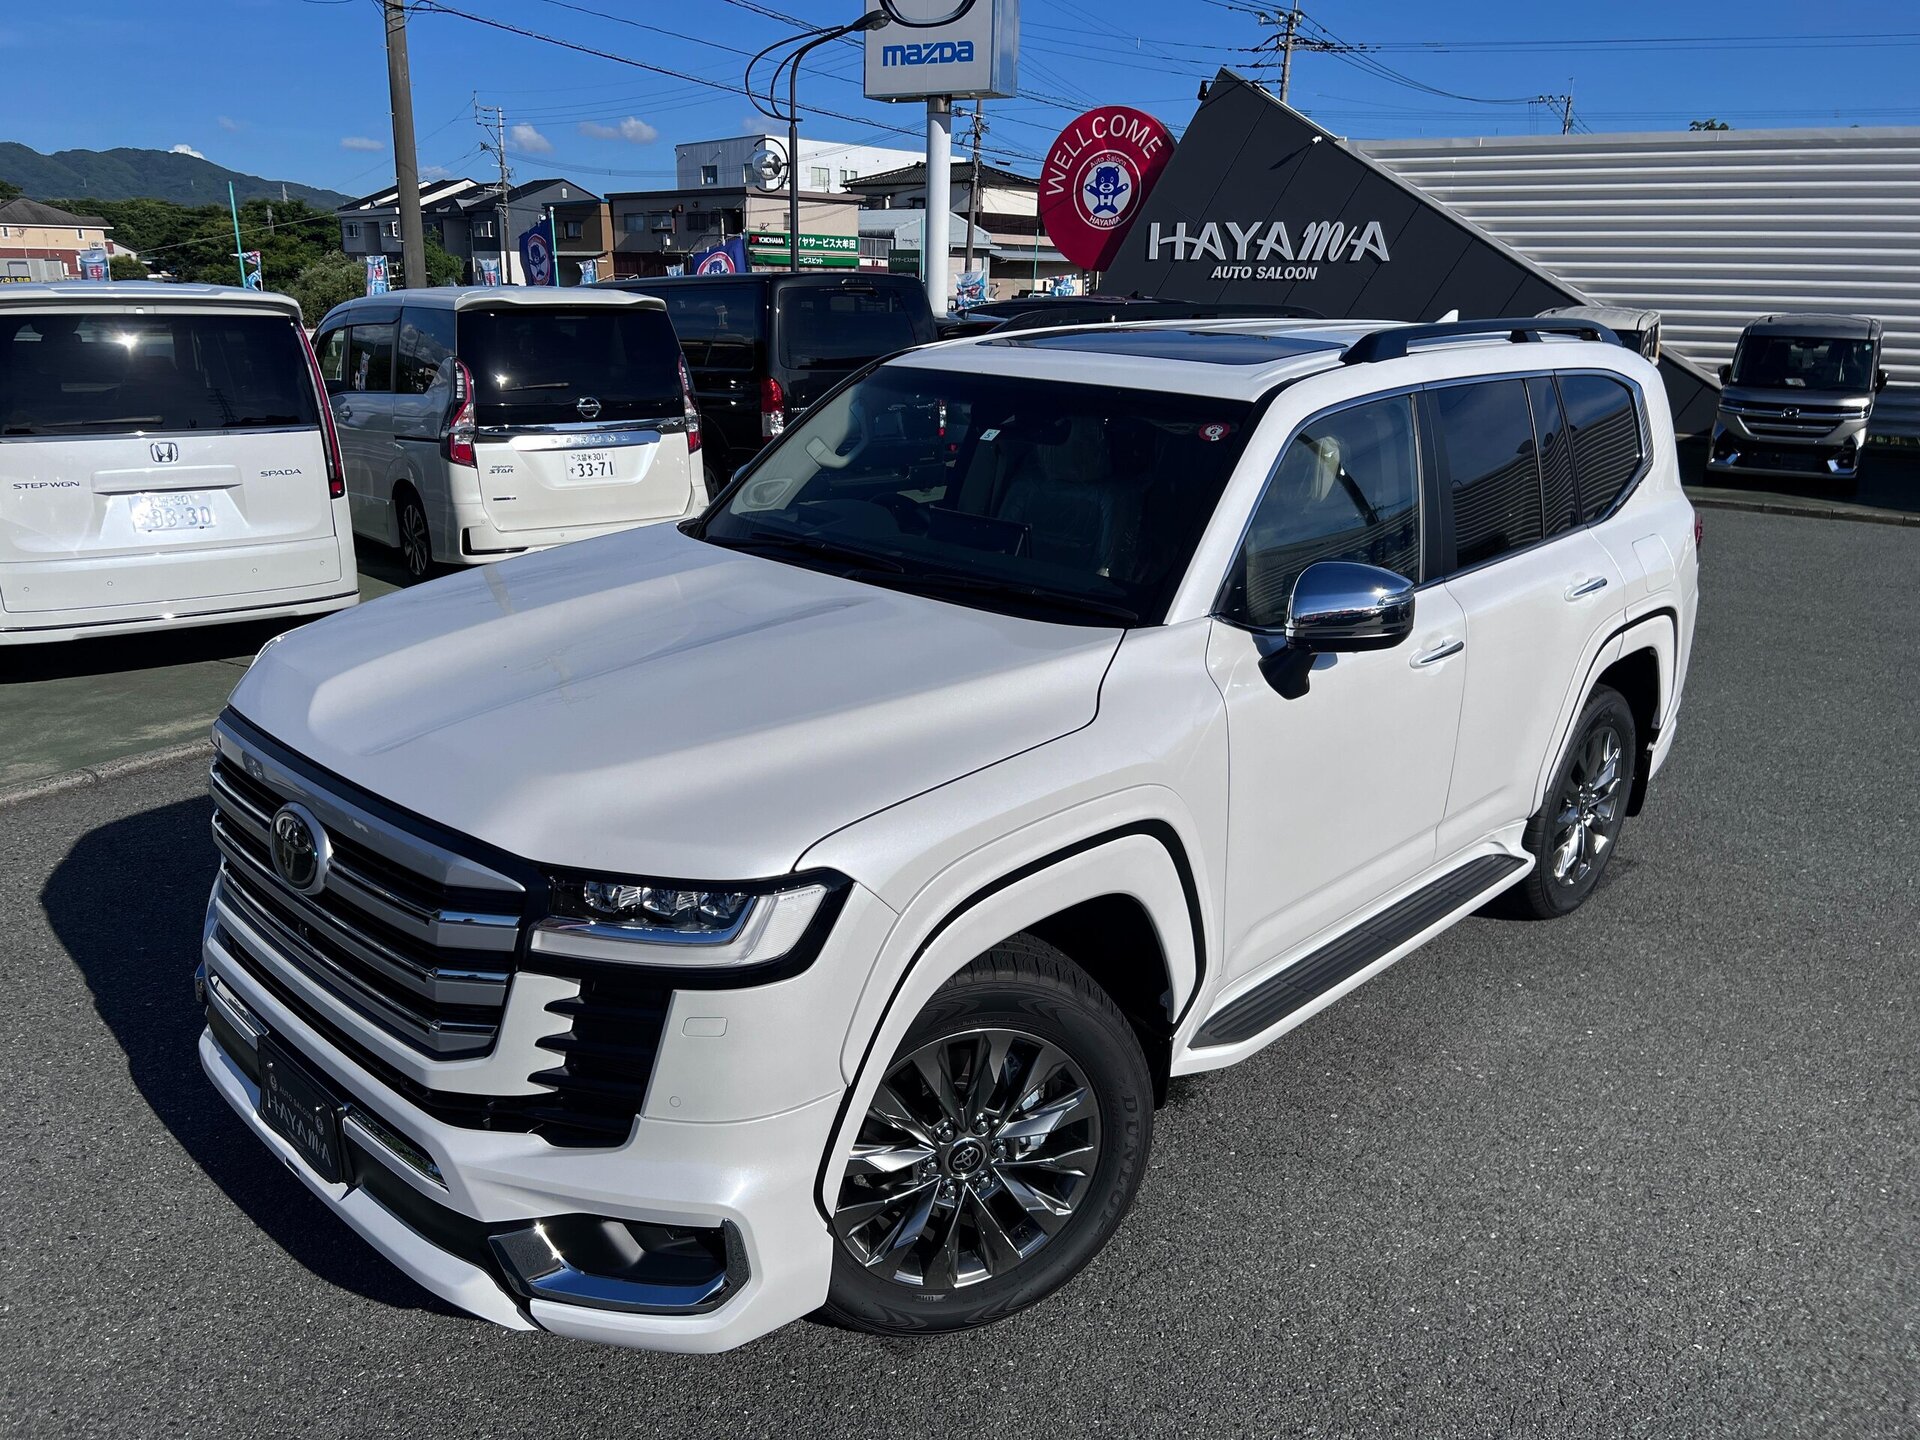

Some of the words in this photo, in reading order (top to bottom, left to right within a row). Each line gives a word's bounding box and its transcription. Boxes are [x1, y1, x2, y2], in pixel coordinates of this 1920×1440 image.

[1046, 114, 1163, 195] WELLCOME
[1089, 157, 1105, 168] Auto
[1106, 154, 1127, 167] Saloon
[1089, 215, 1122, 227] HAYAMA
[758, 235, 785, 245] YOKOHAMA
[788, 236, 856, 249] イヤサービス大牟田
[1148, 220, 1391, 262] HAYAMA
[1211, 265, 1251, 279] AUTO
[1255, 266, 1318, 280] SALOON
[260, 468, 303, 478] SPADA
[577, 461, 614, 478] 33-71
[266, 1088, 333, 1168] HAYAMA
